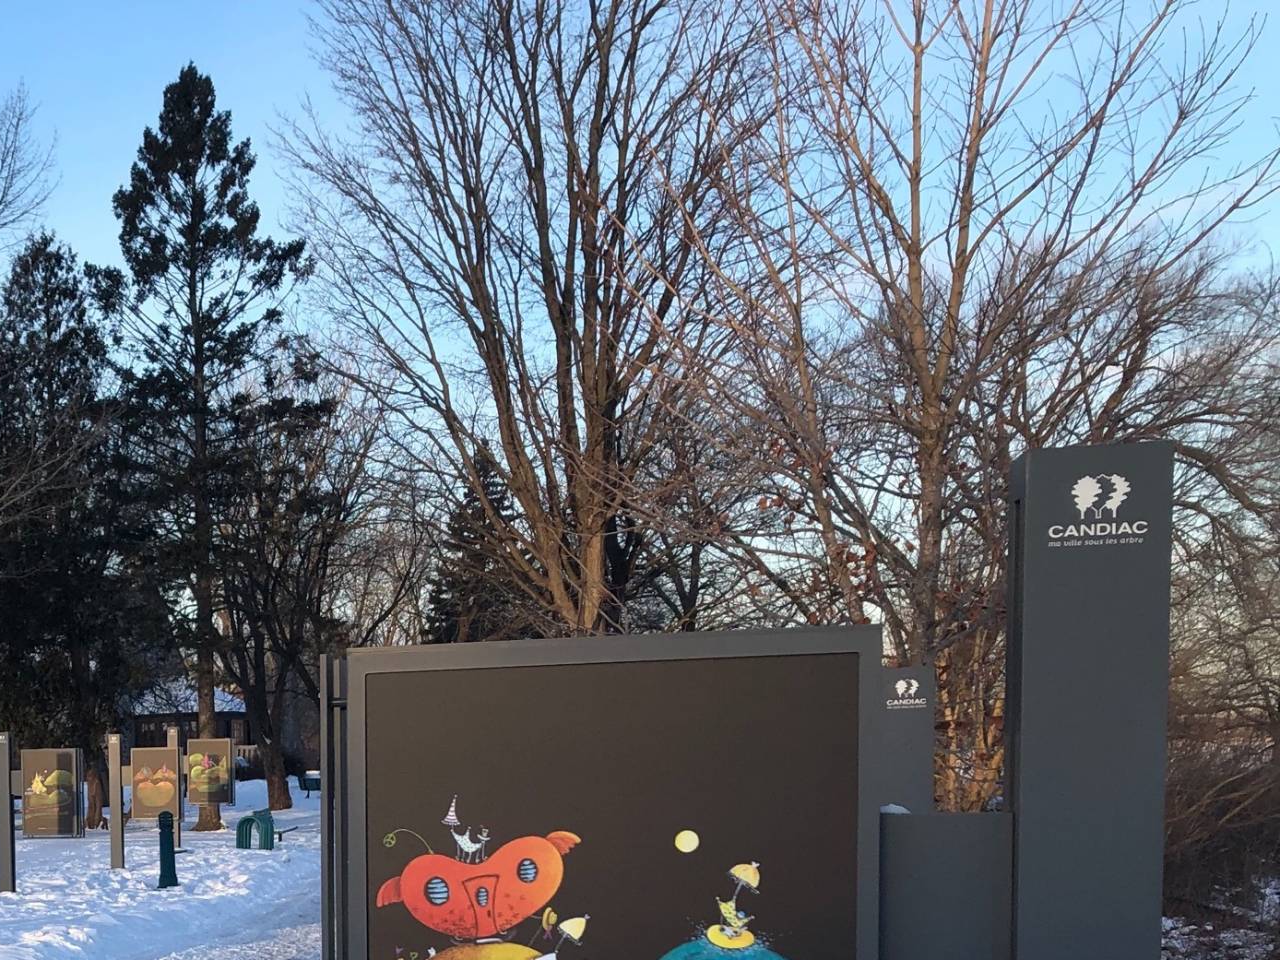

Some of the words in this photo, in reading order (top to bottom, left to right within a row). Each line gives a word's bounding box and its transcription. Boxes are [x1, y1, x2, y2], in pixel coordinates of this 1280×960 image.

[1048, 521, 1148, 538] CANDIAC
[1064, 538, 1081, 547] ville
[1084, 537, 1103, 546] sous
[1106, 536, 1118, 545] les
[886, 698, 927, 706] CANDIAC
